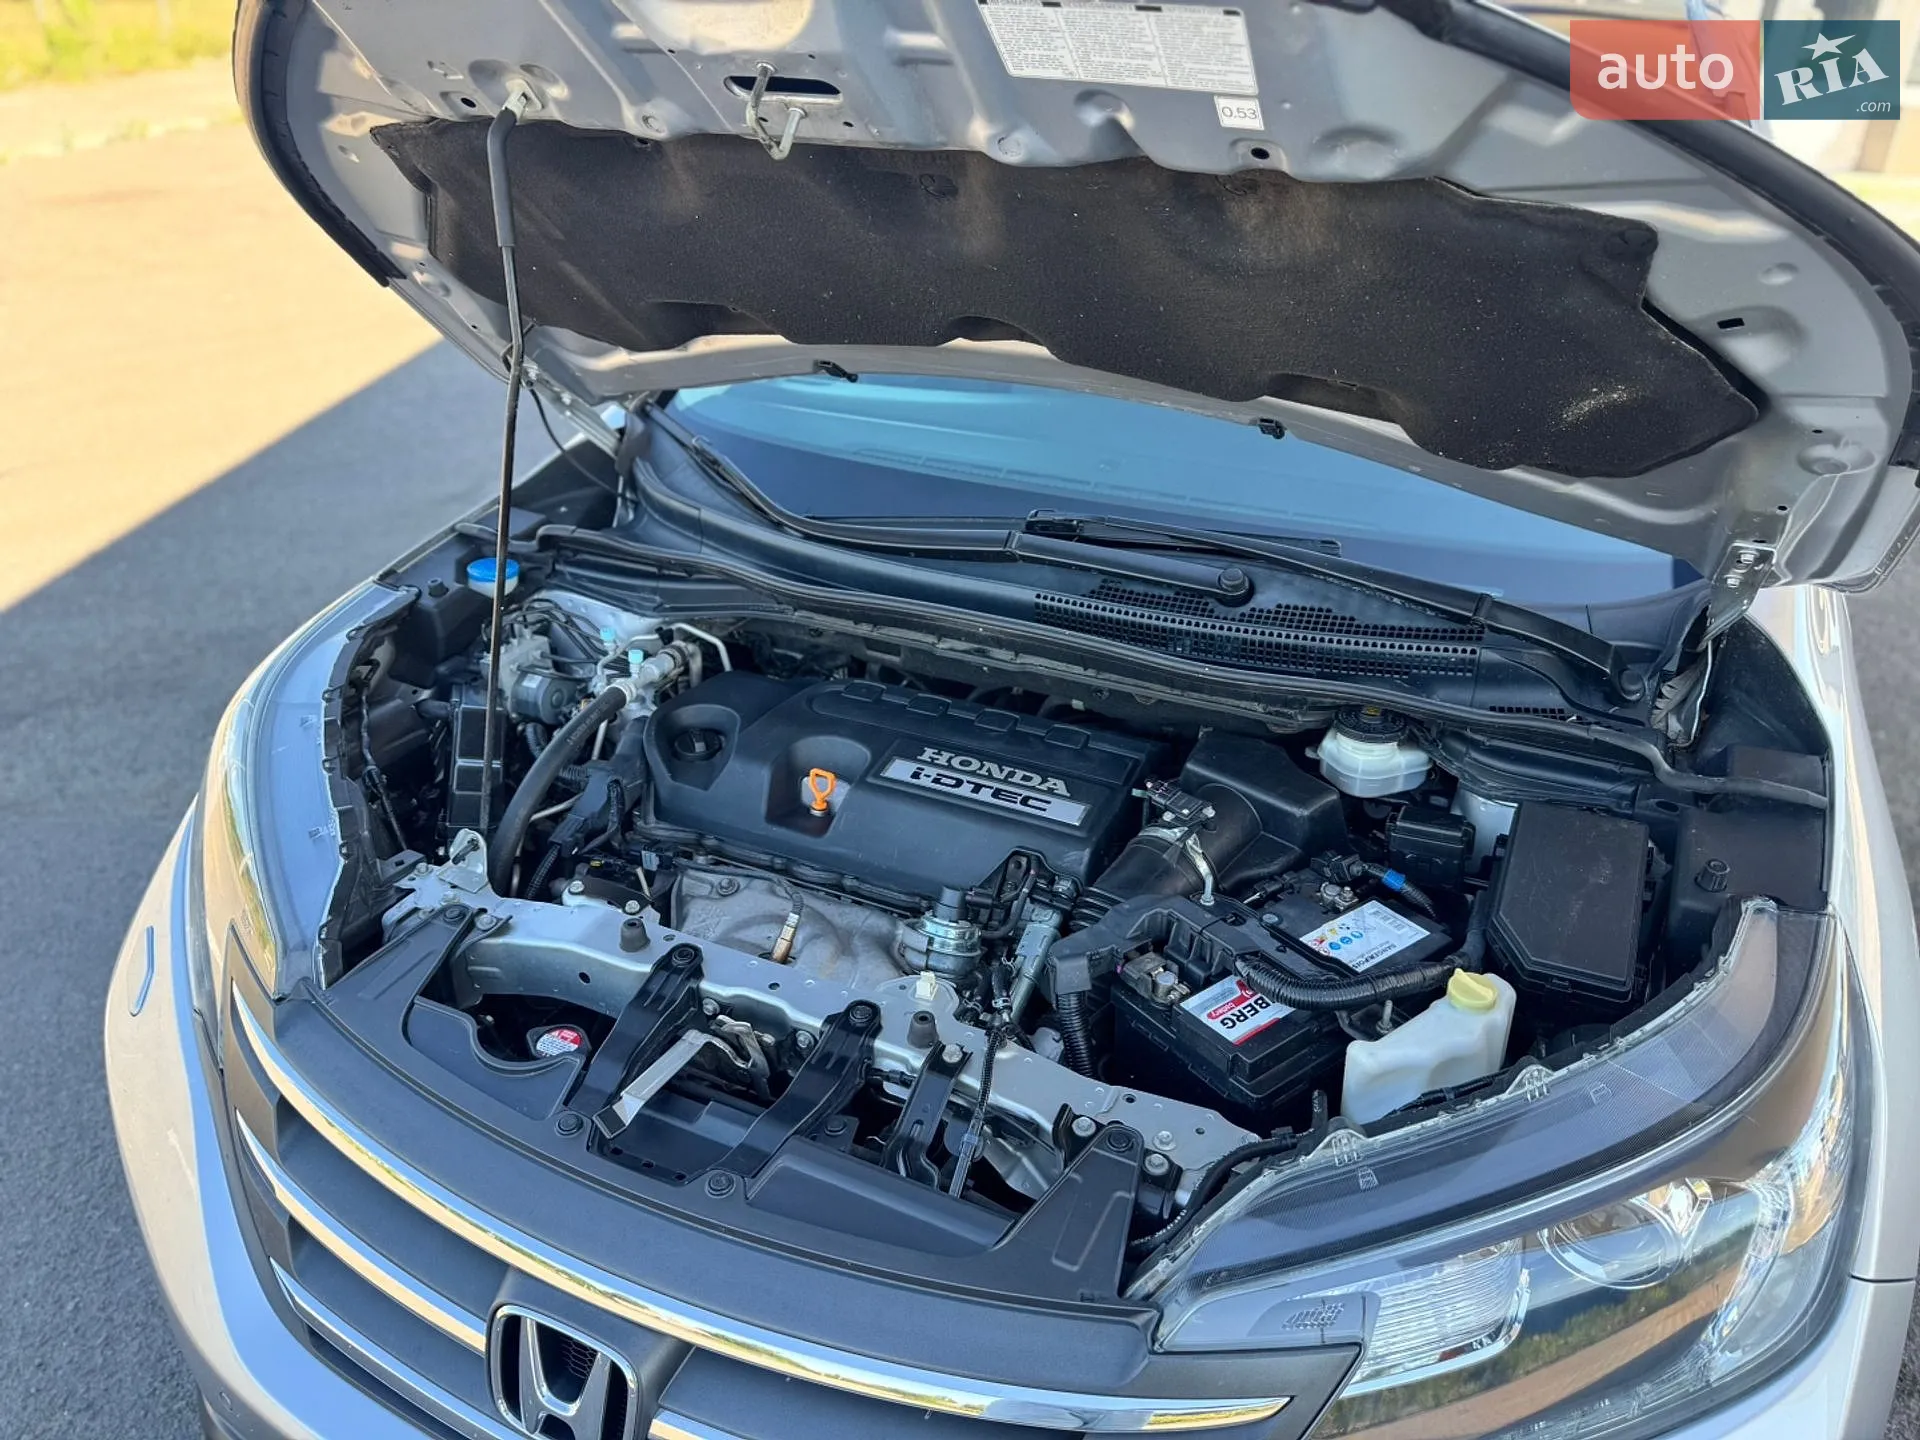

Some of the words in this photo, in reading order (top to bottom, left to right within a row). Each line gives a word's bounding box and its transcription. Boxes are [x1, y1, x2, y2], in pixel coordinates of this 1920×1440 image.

[1221, 106, 1258, 120] 0.53
[909, 767, 1051, 812] i-DTEC
[916, 747, 1071, 796] HONDA
[1220, 996, 1271, 1030] BERG
